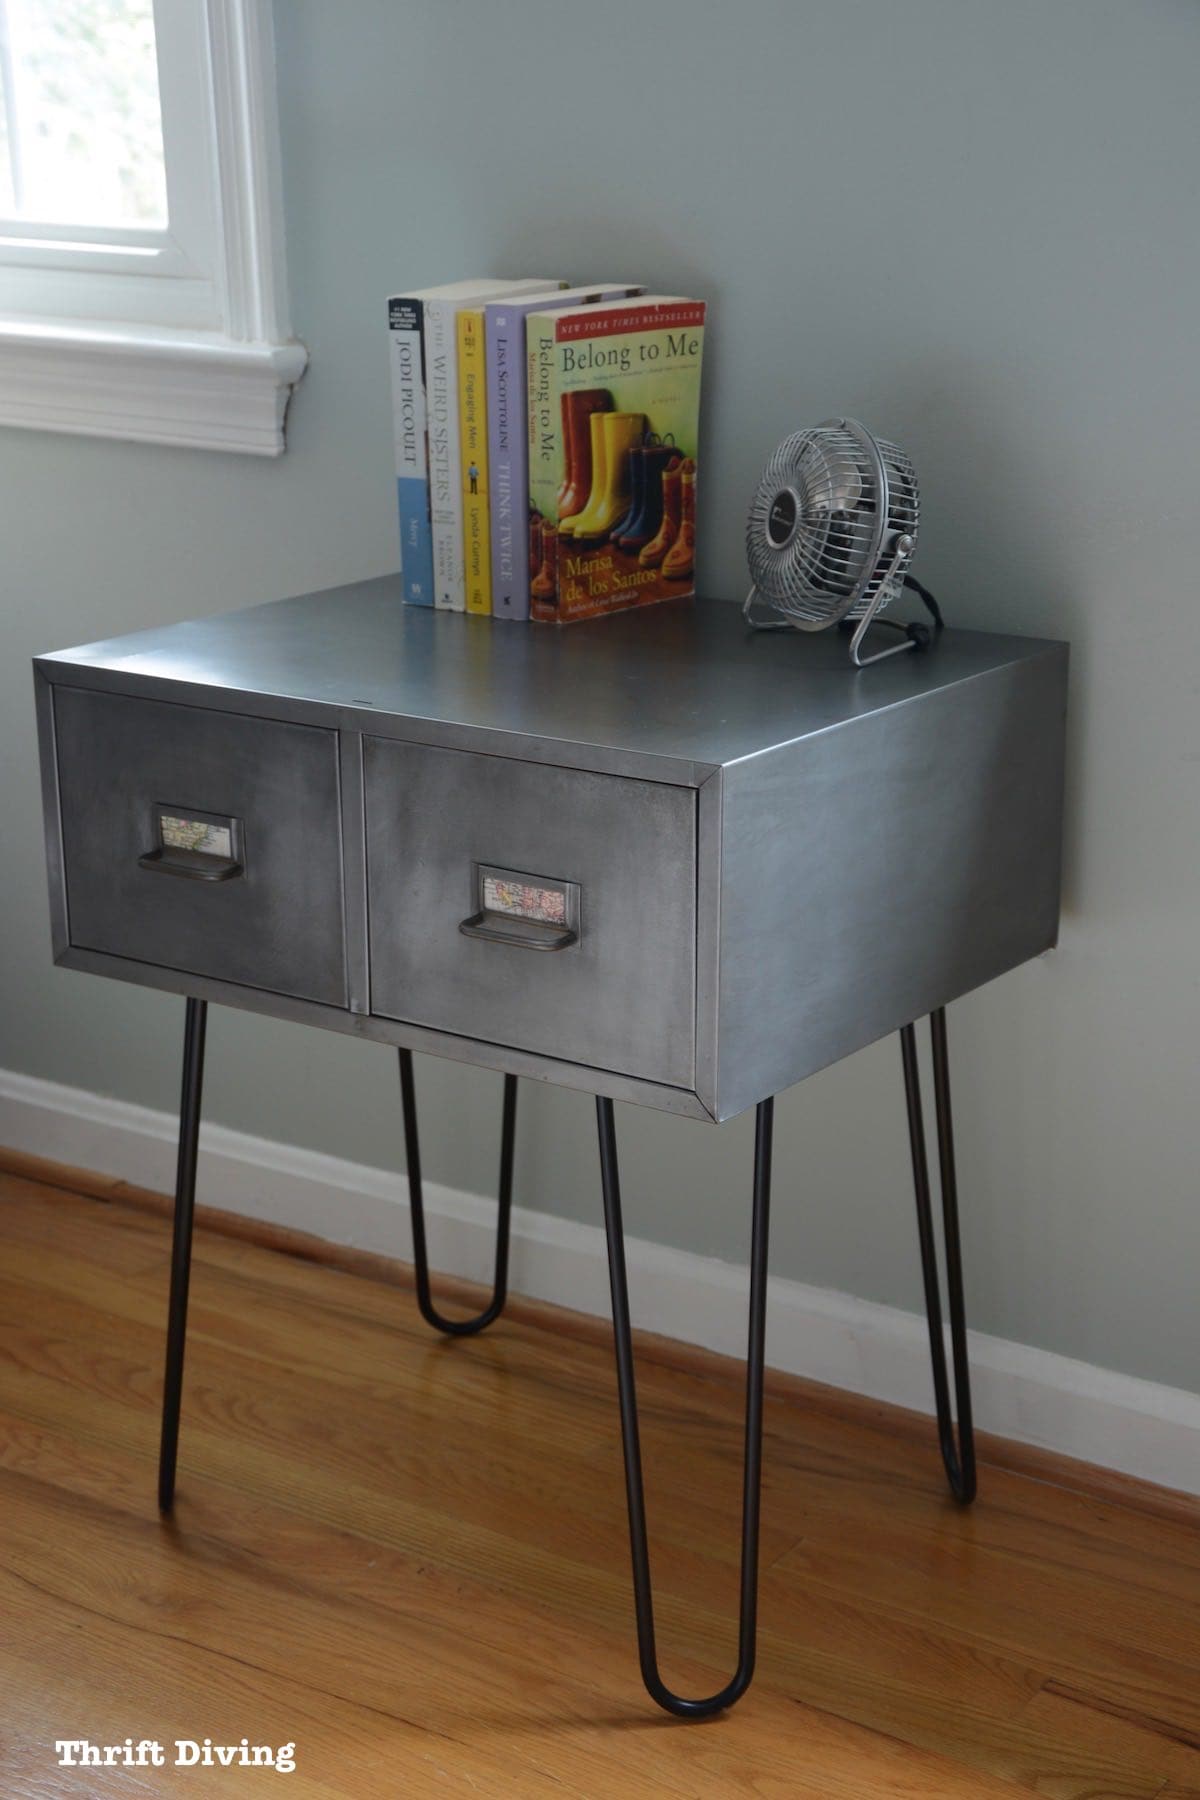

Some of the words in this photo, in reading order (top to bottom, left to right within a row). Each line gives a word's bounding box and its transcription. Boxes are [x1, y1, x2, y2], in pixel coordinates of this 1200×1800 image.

[395, 338, 413, 382] JODI
[497, 338, 508, 367] LISA
[538, 337, 554, 401] Belong
[562, 342, 630, 372] Belong
[640, 344, 660, 362] to
[666, 333, 699, 358] Me
[433, 355, 448, 423] WEIRD
[465, 373, 476, 422] Engaging
[401, 388, 417, 467] PICOULT
[497, 370, 509, 451] SCOTTOLINE
[541, 409, 551, 427] to
[468, 425, 478, 449] Men
[541, 431, 554, 461] Me
[498, 463, 512, 518] THINK
[470, 507, 480, 537] Lynda
[500, 522, 513, 581] TWICE
[565, 556, 613, 578] Marisa
[566, 579, 584, 602] de
[588, 575, 609, 597] los
[612, 569, 657, 592] Santos
